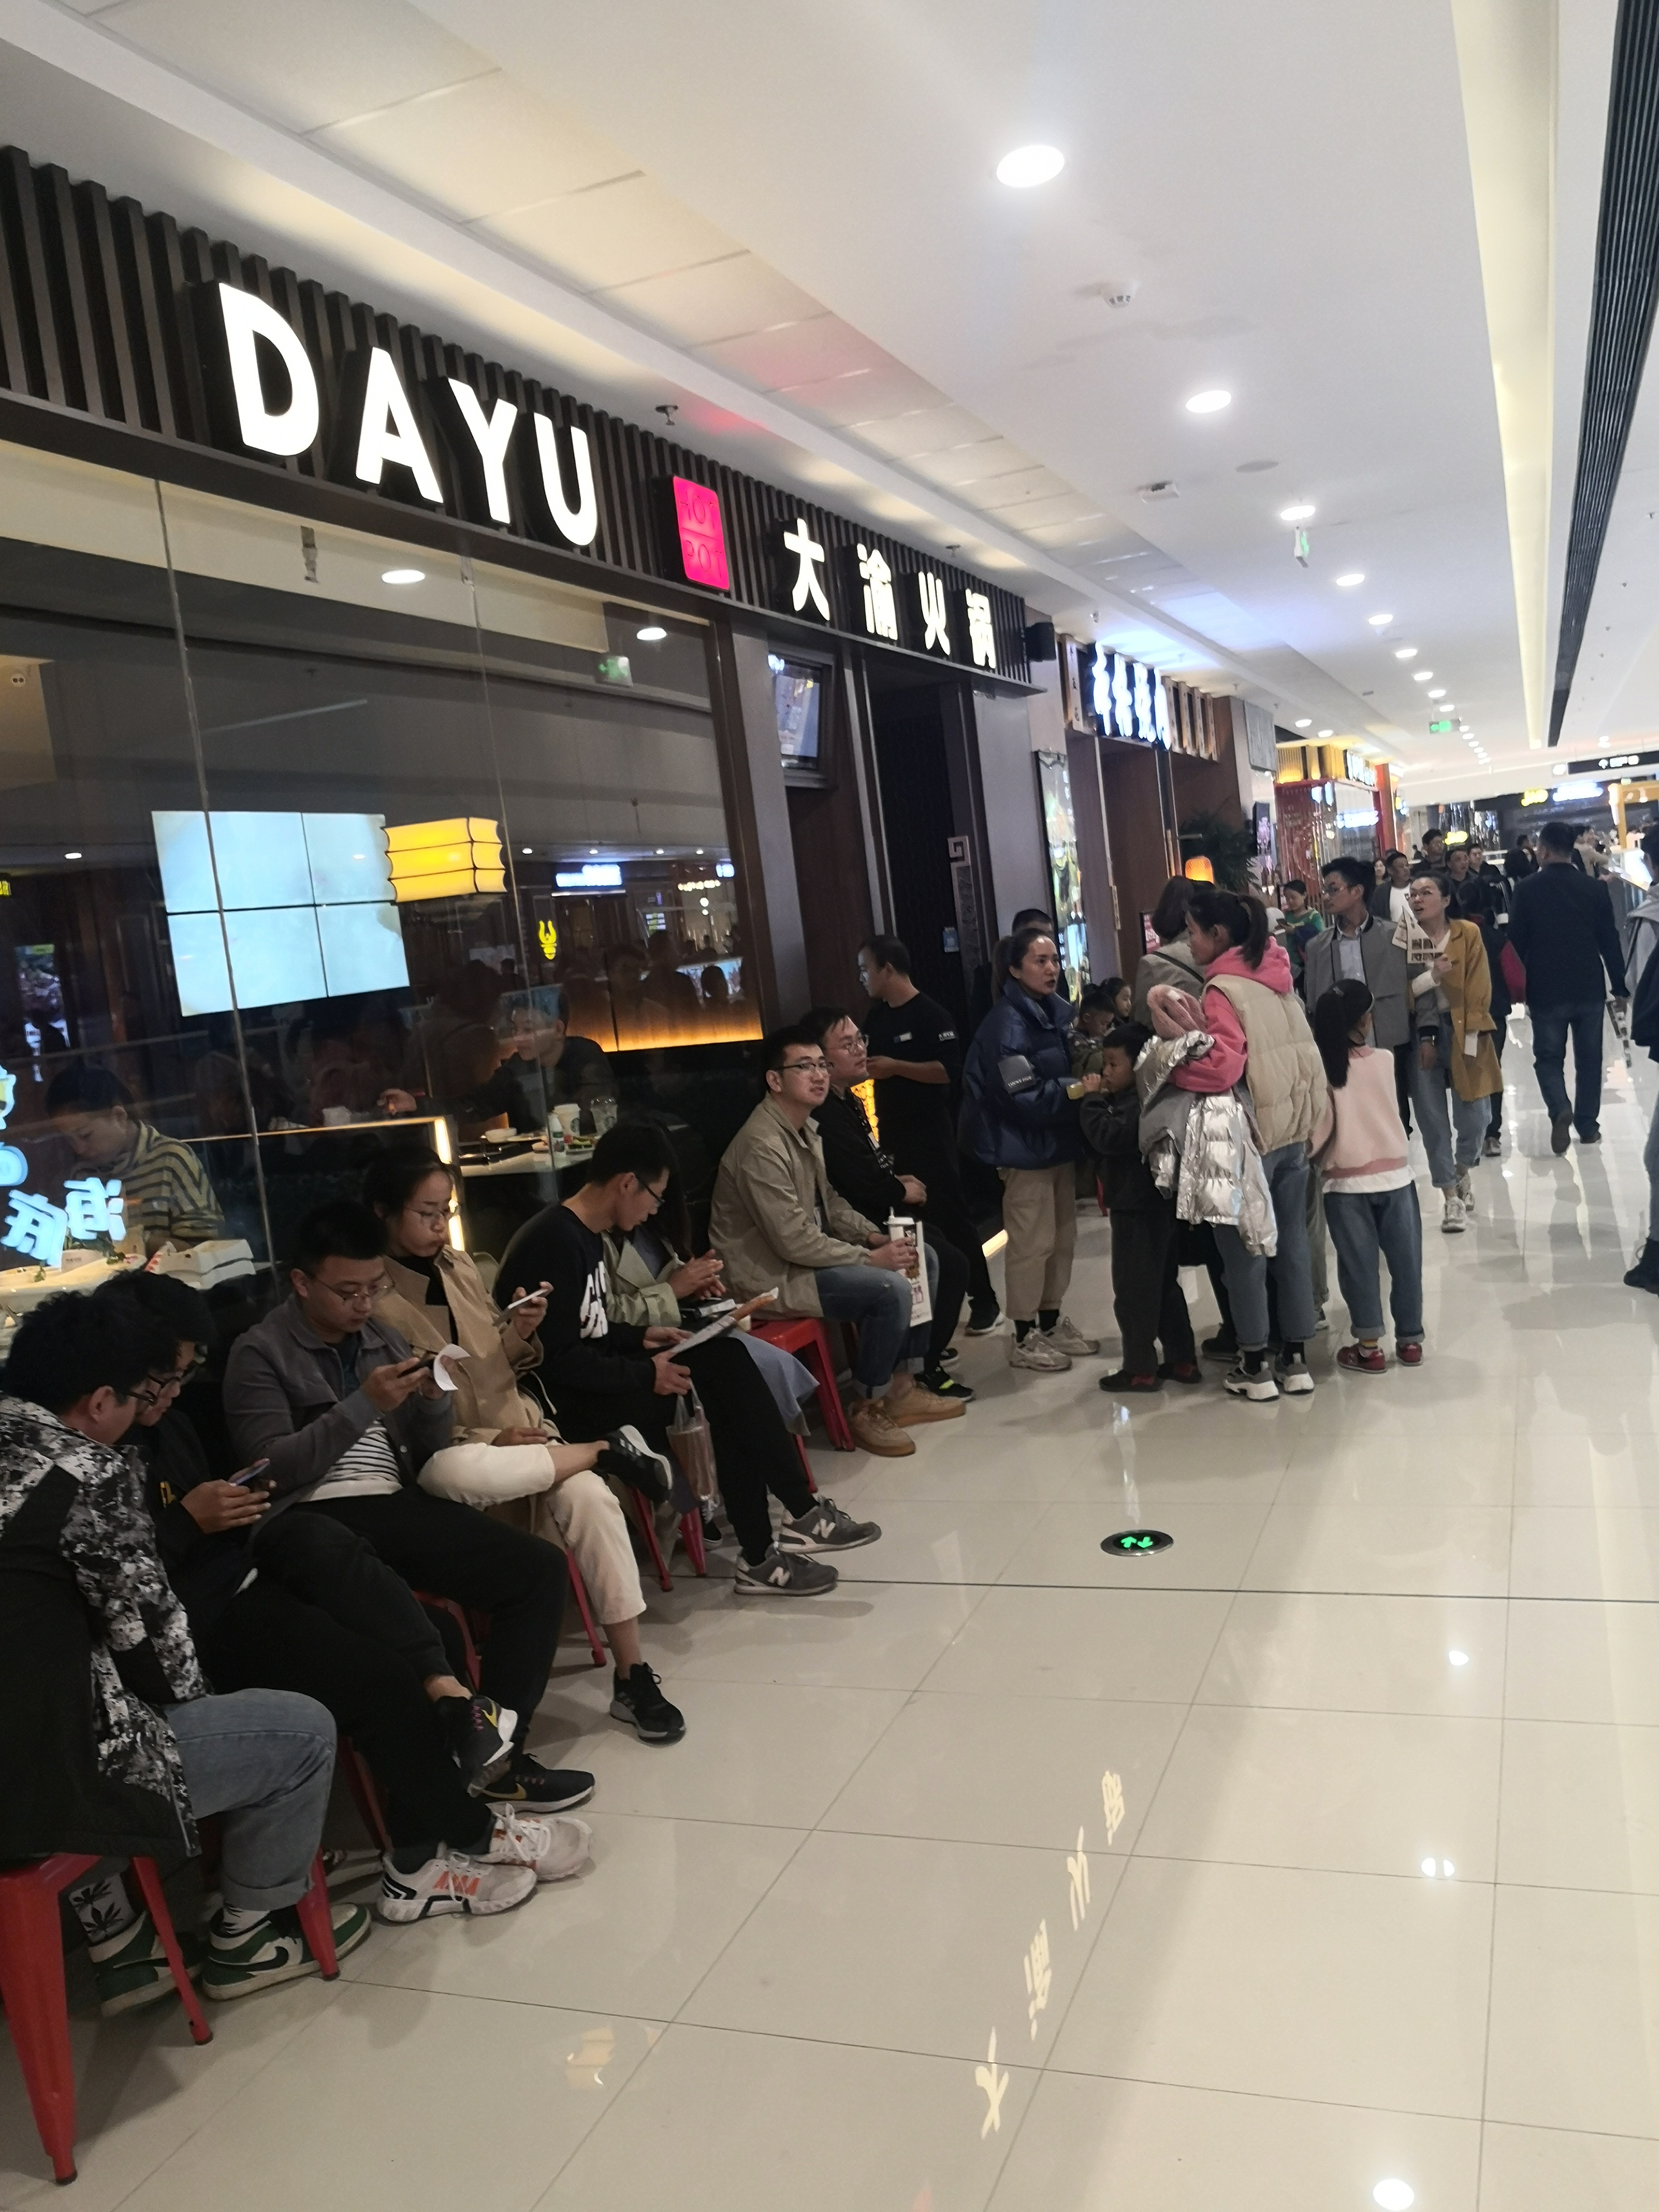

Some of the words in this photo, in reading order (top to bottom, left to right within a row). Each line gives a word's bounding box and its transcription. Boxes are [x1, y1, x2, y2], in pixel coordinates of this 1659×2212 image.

[219, 282, 598, 546] DAYU
[677, 487, 716, 531] HOT
[685, 539, 723, 580] POT
[783, 517, 997, 669] 大渝火锅
